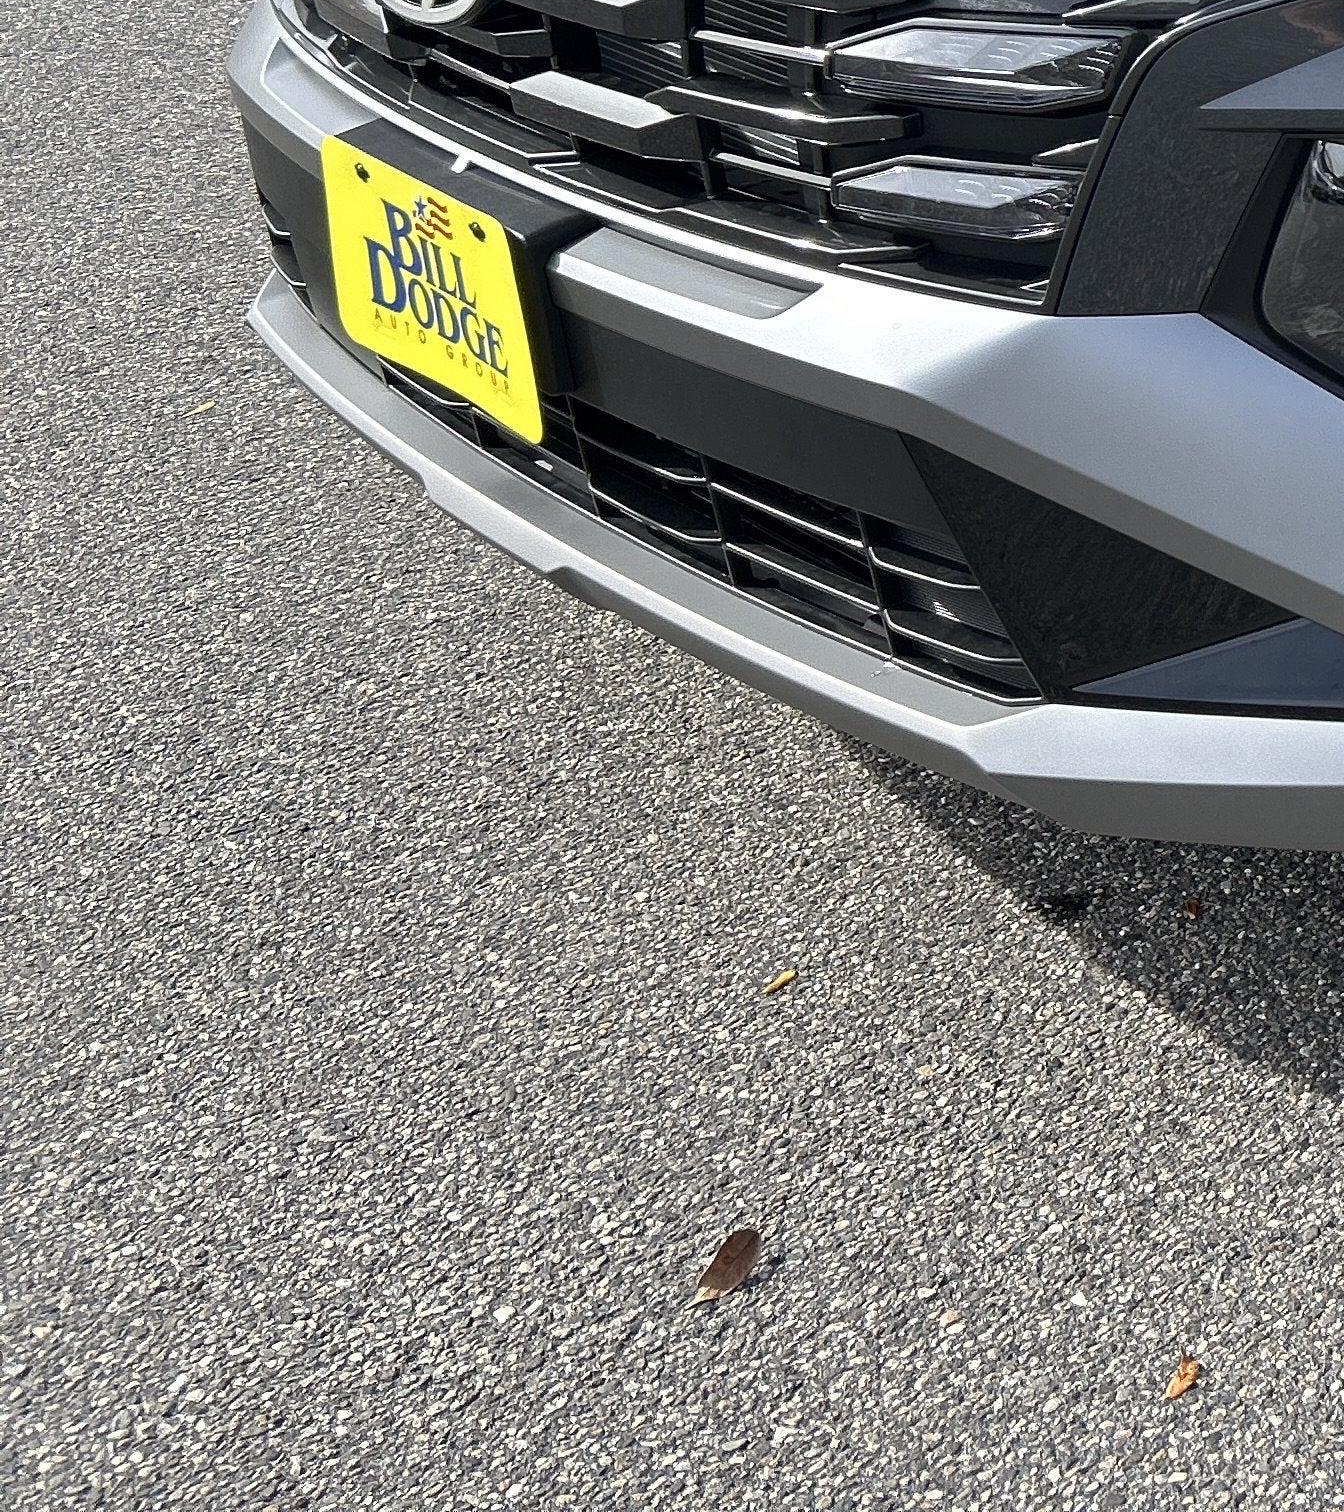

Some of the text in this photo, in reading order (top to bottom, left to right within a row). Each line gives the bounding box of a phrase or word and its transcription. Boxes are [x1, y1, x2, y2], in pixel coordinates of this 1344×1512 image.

[363, 235, 509, 379] DODGE
[380, 198, 477, 309] BILL
[374, 308, 510, 394] AUTO GROUP
